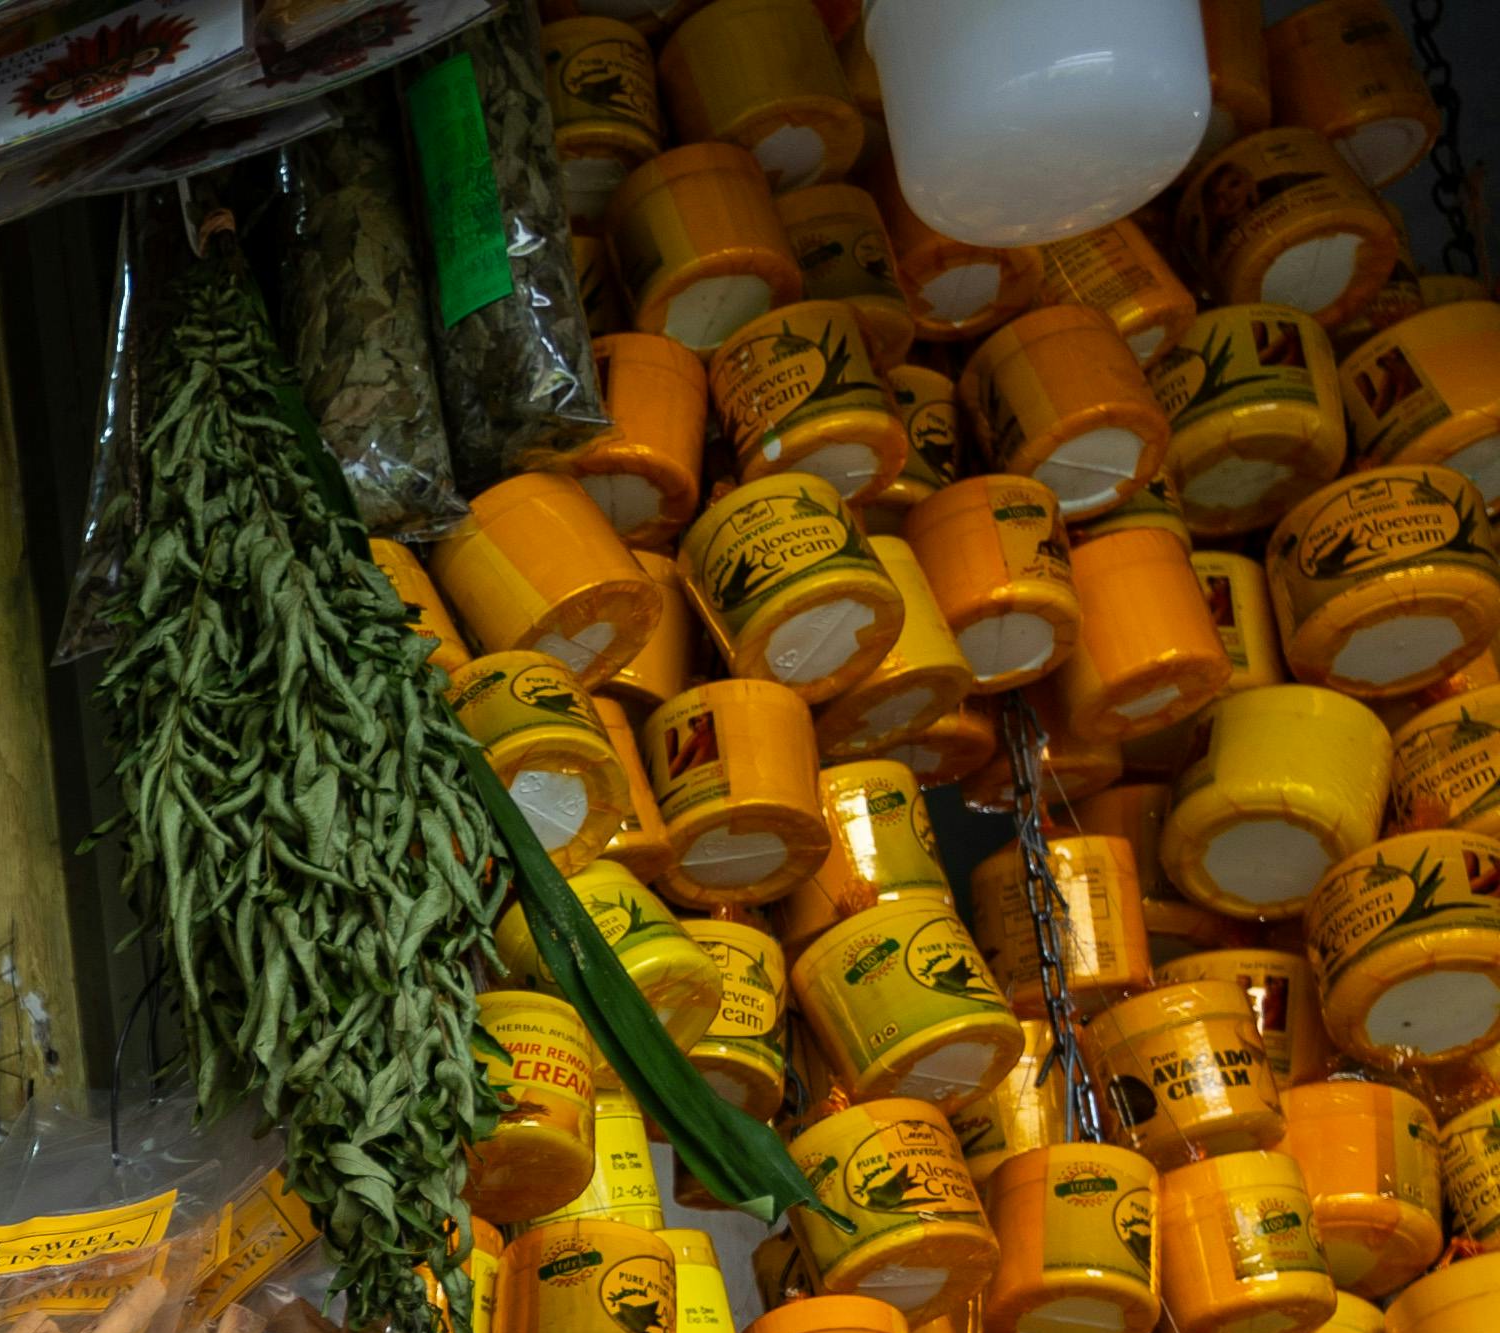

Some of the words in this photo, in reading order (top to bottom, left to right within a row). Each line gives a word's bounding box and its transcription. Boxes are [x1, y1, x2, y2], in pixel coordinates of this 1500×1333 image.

[1359, 513, 1442, 539] Aloevera
[750, 523, 830, 557] Aloevera
[1367, 528, 1447, 551] Cream
[761, 537, 838, 571] Cream
[916, 943, 940, 955] PURE
[496, 1024, 544, 1034] HERBAL
[1149, 1049, 1179, 1066] Pure
[514, 1060, 591, 1100] CREAM
[856, 1157, 885, 1169] PURE
[28, 1229, 116, 1253] SWEET
[619, 1271, 643, 1284] PURE
